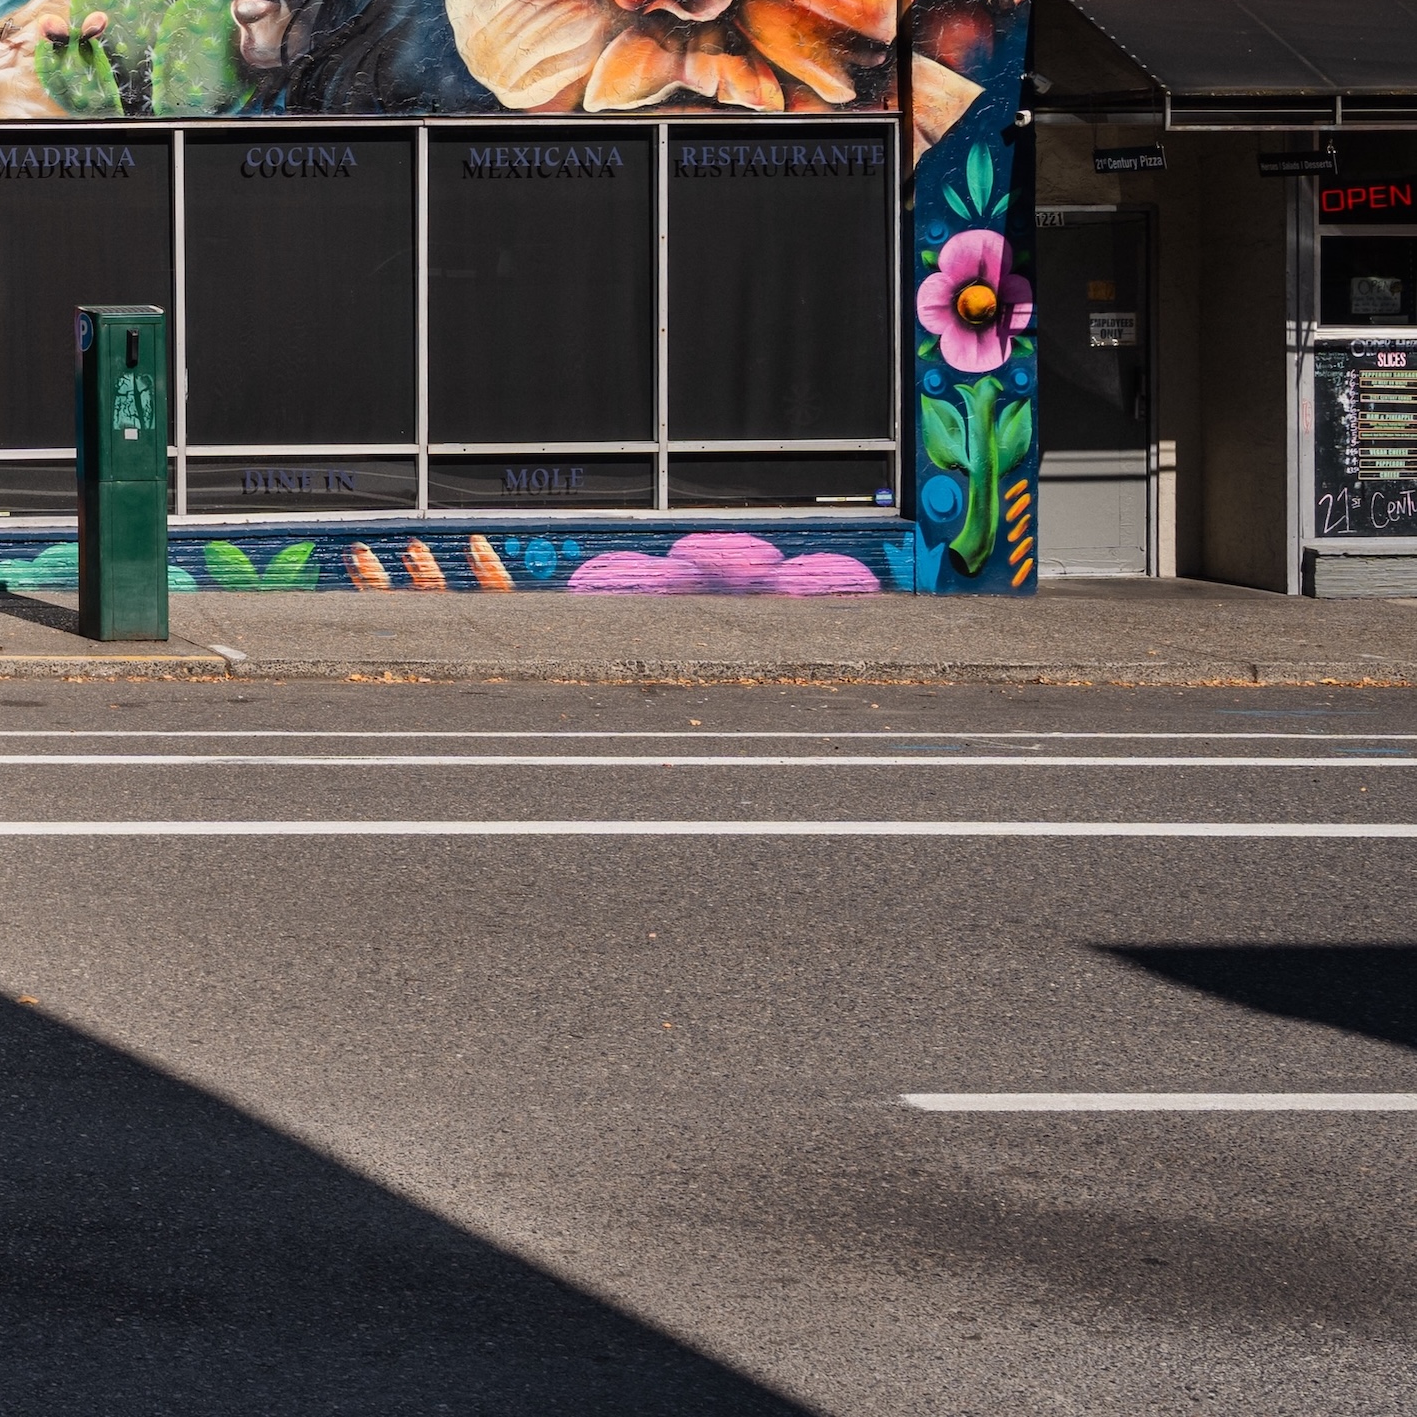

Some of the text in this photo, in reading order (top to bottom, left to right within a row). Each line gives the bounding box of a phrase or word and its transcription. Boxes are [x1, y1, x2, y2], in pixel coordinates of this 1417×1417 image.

[246, 146, 358, 167] COCINA
[469, 146, 624, 167] MEXICANA
[682, 145, 885, 166] RESTAURANTE
[1107, 157, 1138, 170] Century
[1140, 155, 1163, 167] Pizza
[1305, 159, 1332, 169] Desserts
[1321, 184, 1413, 212] OPEN
[1377, 352, 1406, 367] SLICES
[505, 468, 583, 488] MOLE
